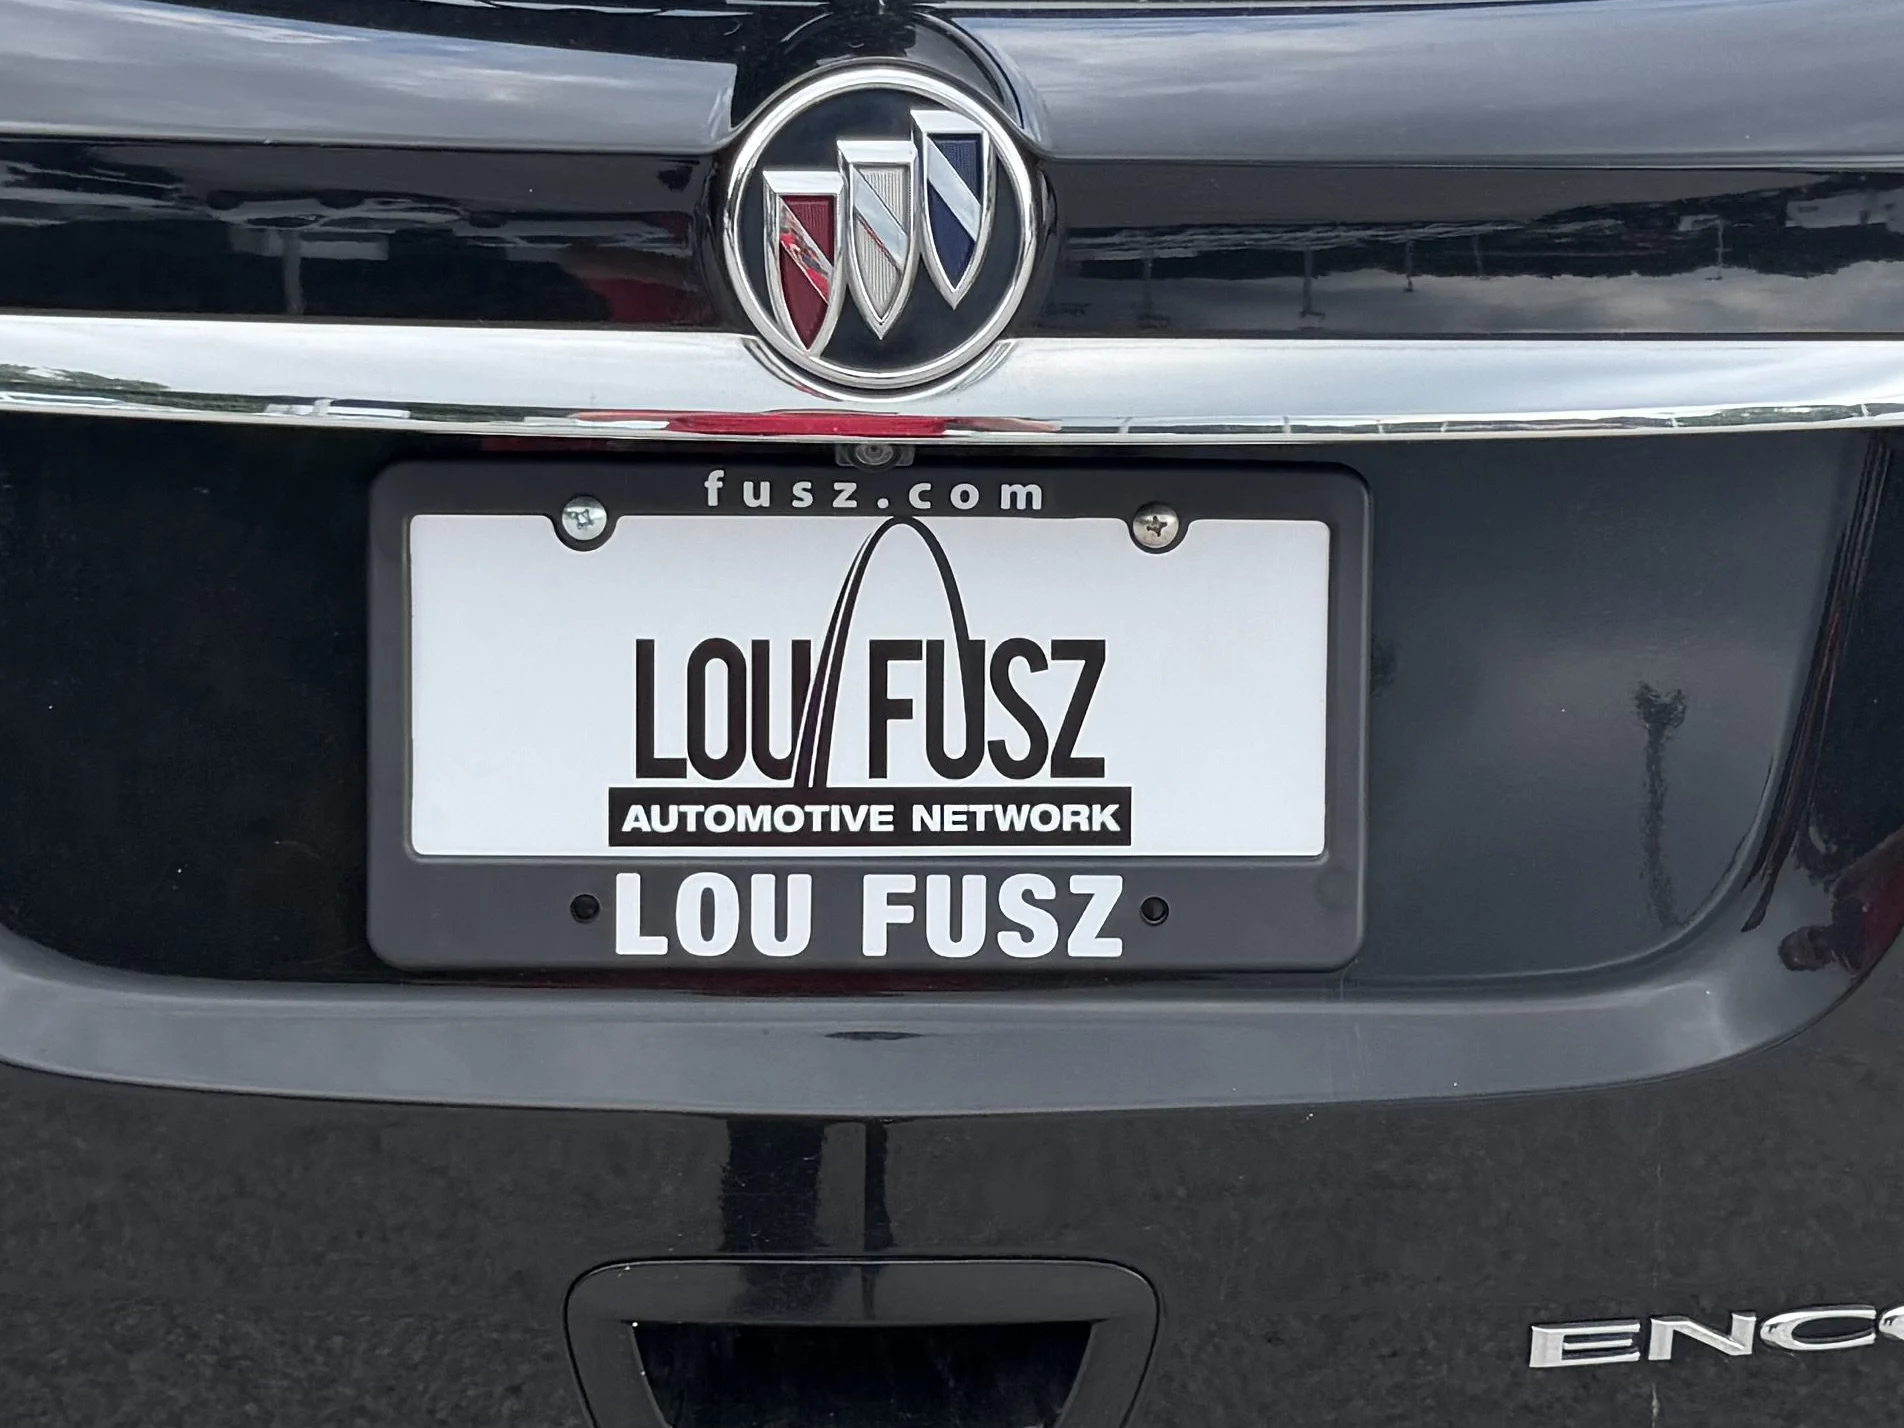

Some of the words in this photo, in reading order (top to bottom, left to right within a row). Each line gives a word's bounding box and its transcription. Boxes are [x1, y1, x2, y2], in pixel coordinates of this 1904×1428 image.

[703, 469, 1043, 510] fusz.com
[635, 637, 813, 781] LOU
[868, 637, 1107, 781] FUSZ
[621, 803, 895, 834] AUTOMOTIVE
[911, 802, 1121, 834] NETWORK
[614, 871, 814, 958] LOU
[861, 872, 1124, 959] FUSZ
